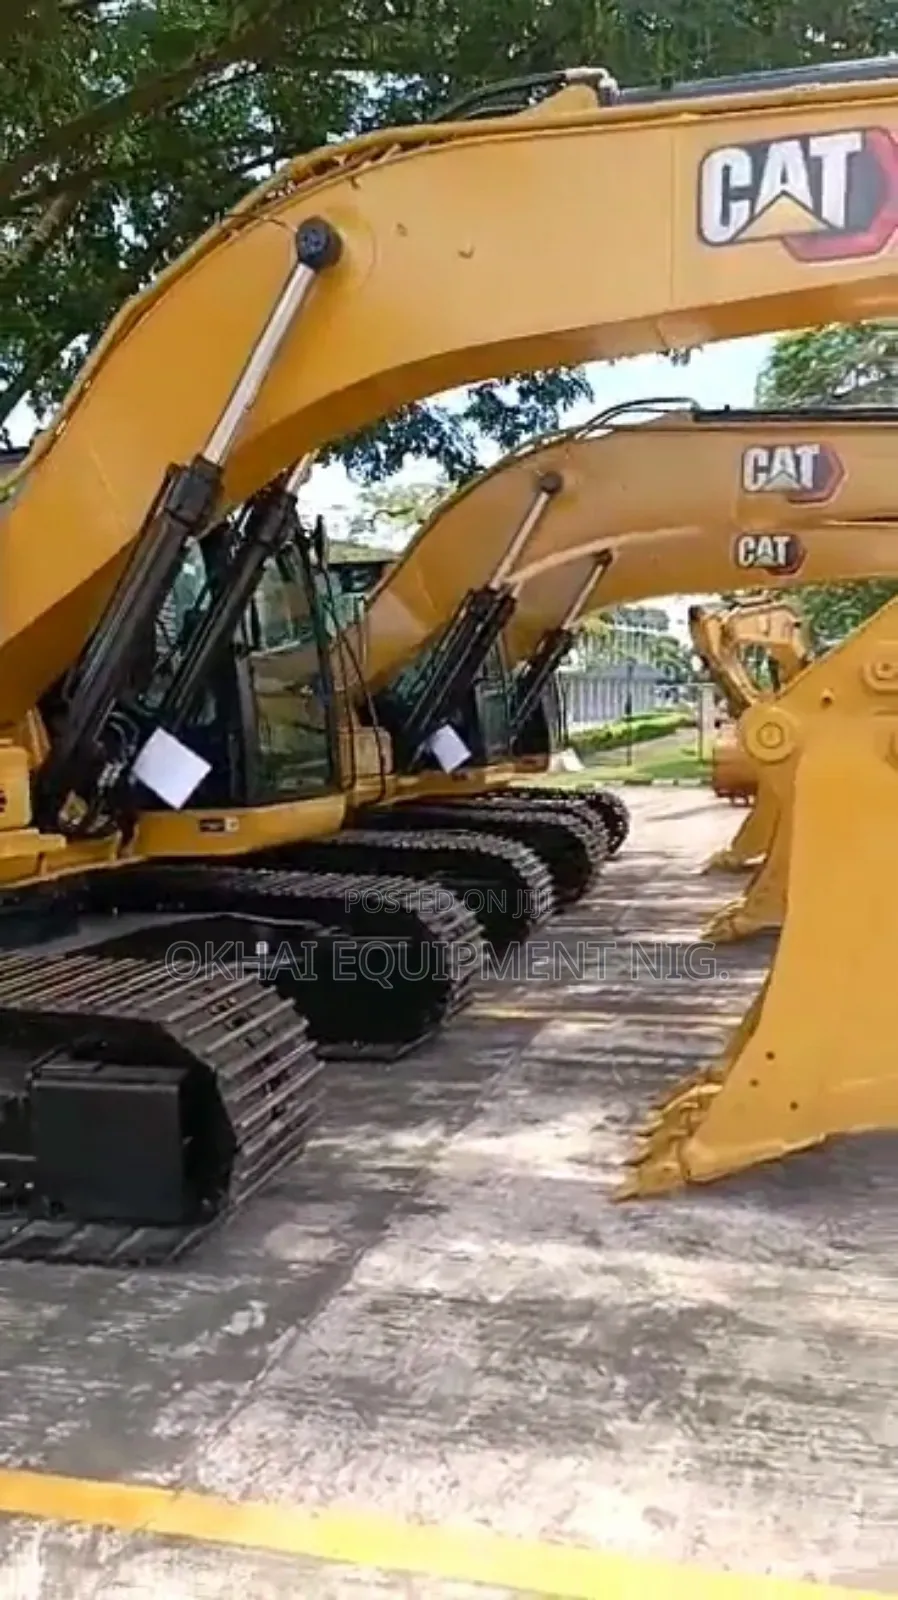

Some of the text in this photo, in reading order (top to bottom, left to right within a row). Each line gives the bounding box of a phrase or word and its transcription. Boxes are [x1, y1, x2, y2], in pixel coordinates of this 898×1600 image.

[701, 131, 863, 243] CAT
[743, 443, 821, 492] CAT
[738, 535, 790, 567] CAT
